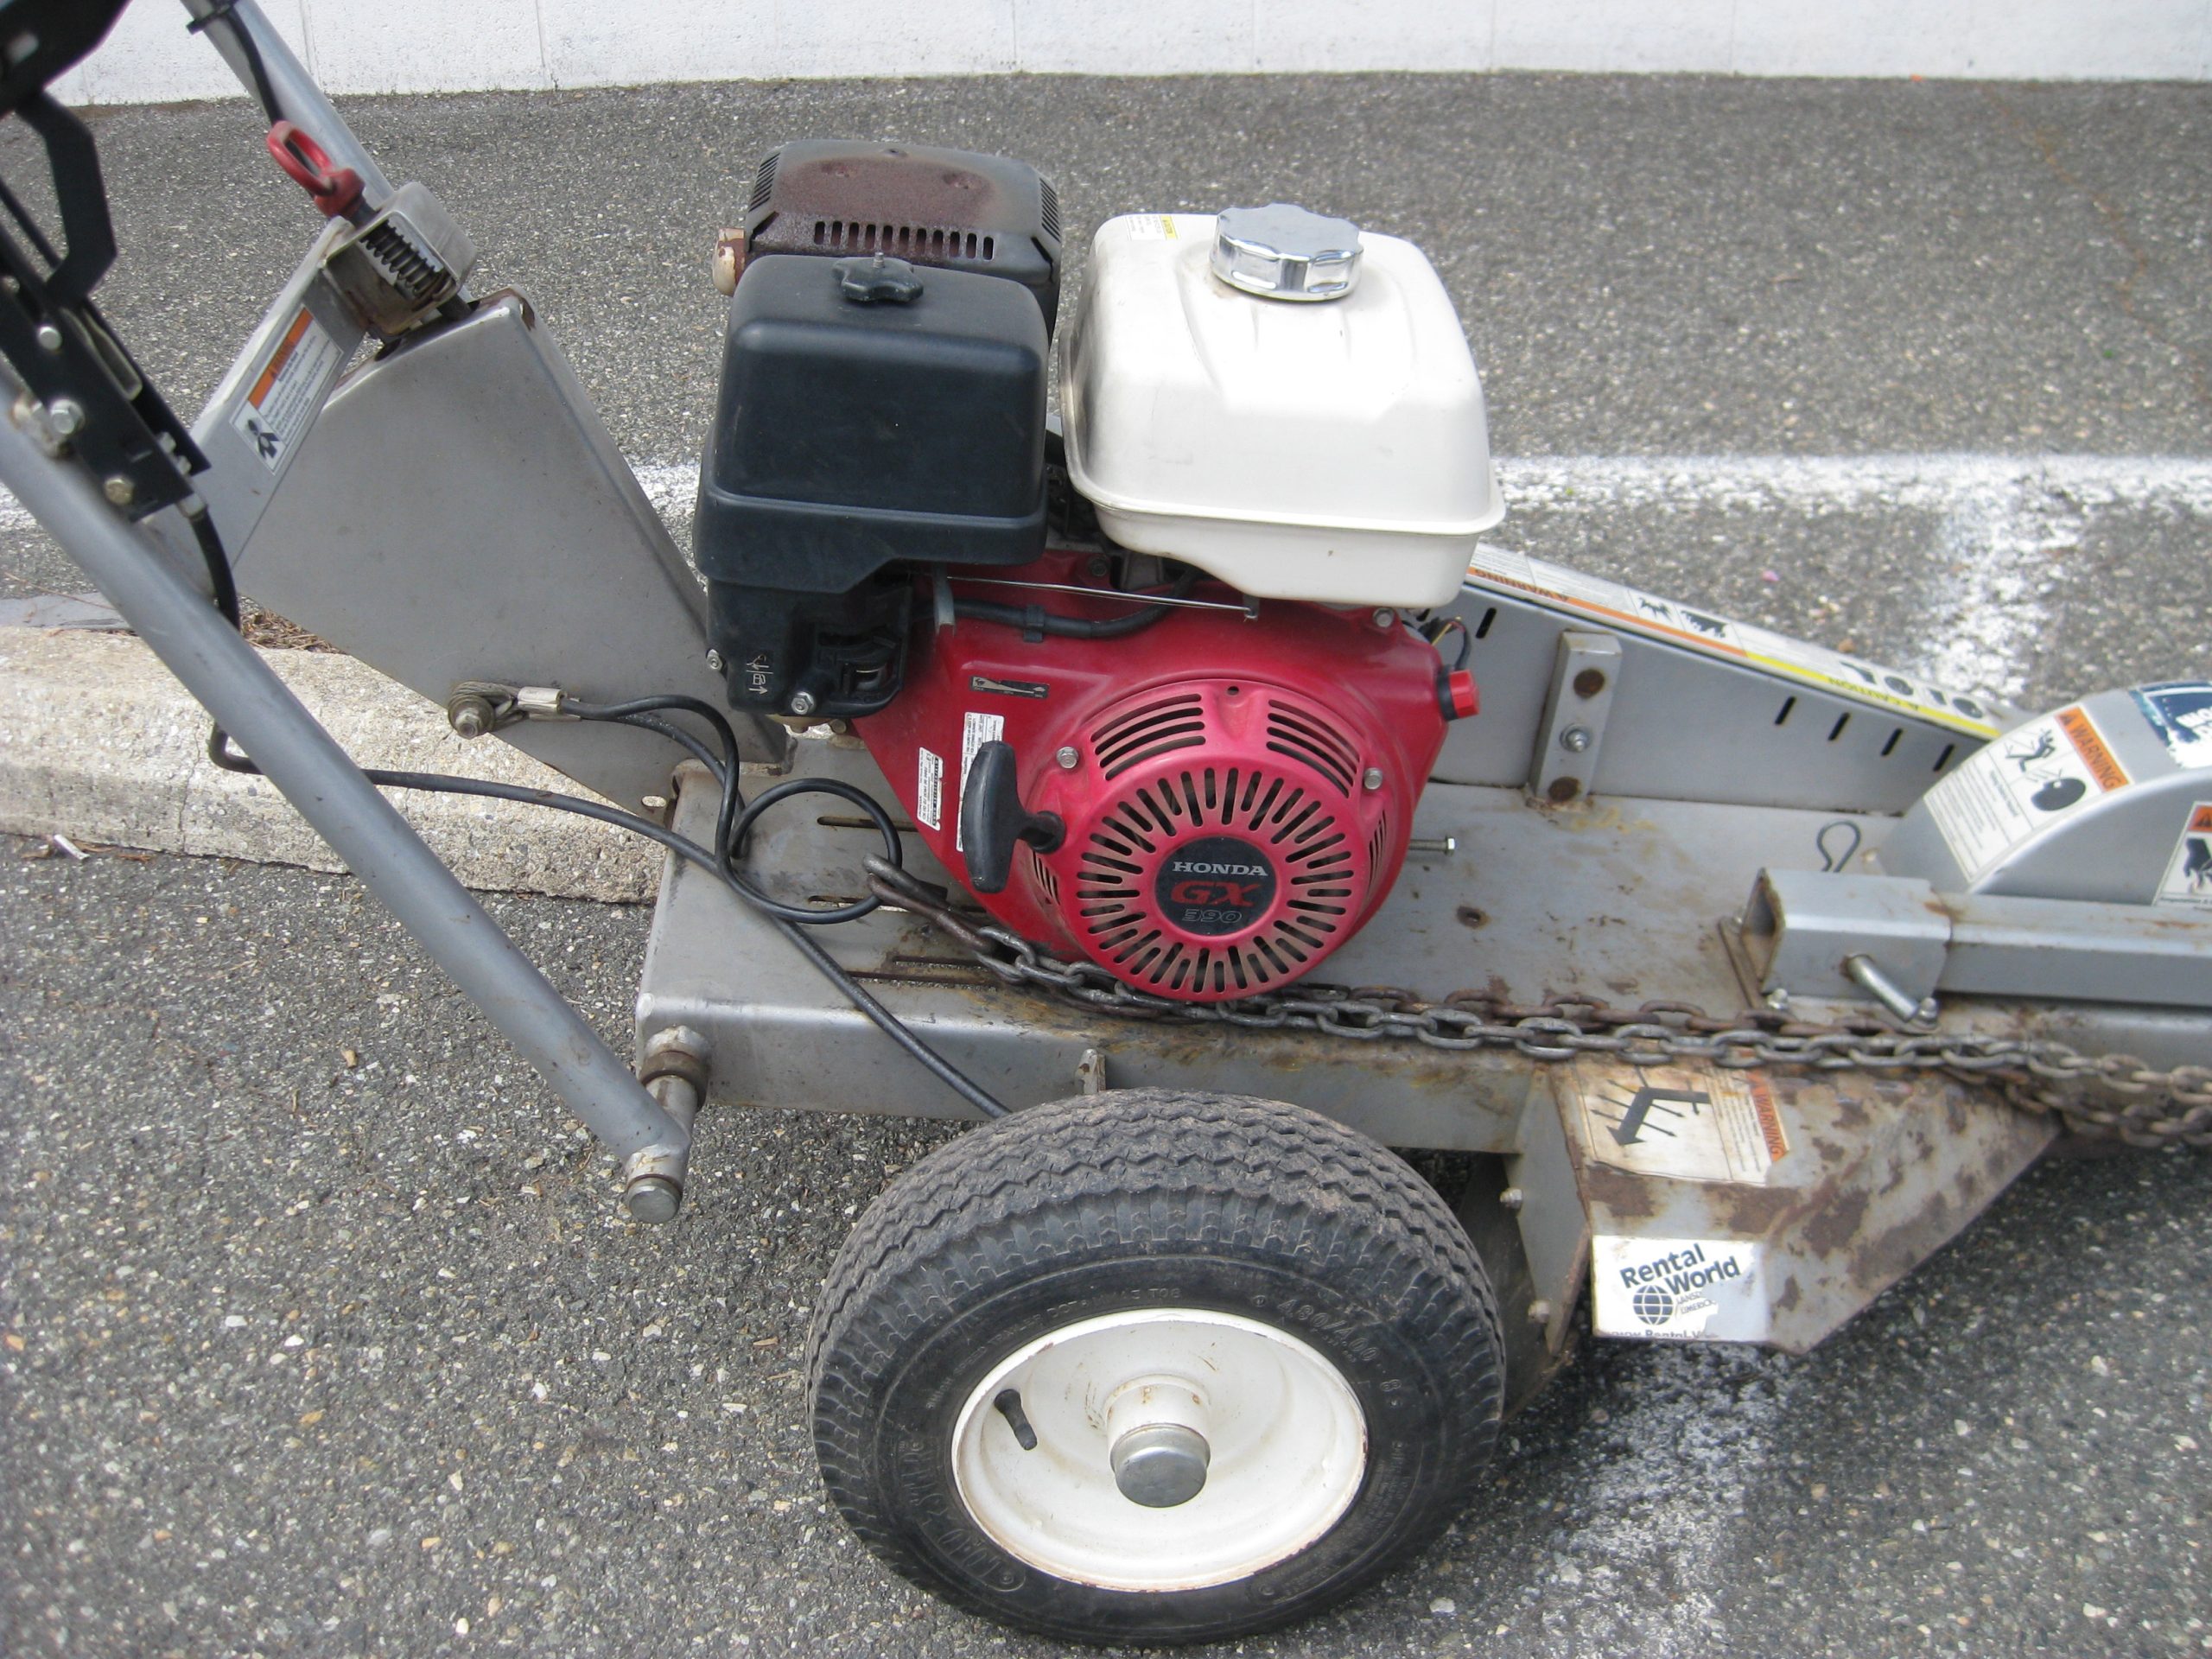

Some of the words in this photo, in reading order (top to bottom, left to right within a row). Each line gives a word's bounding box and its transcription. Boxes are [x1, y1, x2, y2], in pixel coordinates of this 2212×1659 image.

[2073, 722, 2121, 788] WARNING
[1173, 861, 1268, 877] HONDA
[1171, 881, 1262, 907] GX
[1182, 908, 1243, 924] 390
[1754, 1094, 1785, 1154] WARNING
[1619, 1243, 1706, 1288] Rental
[1663, 1255, 1741, 1295] World
